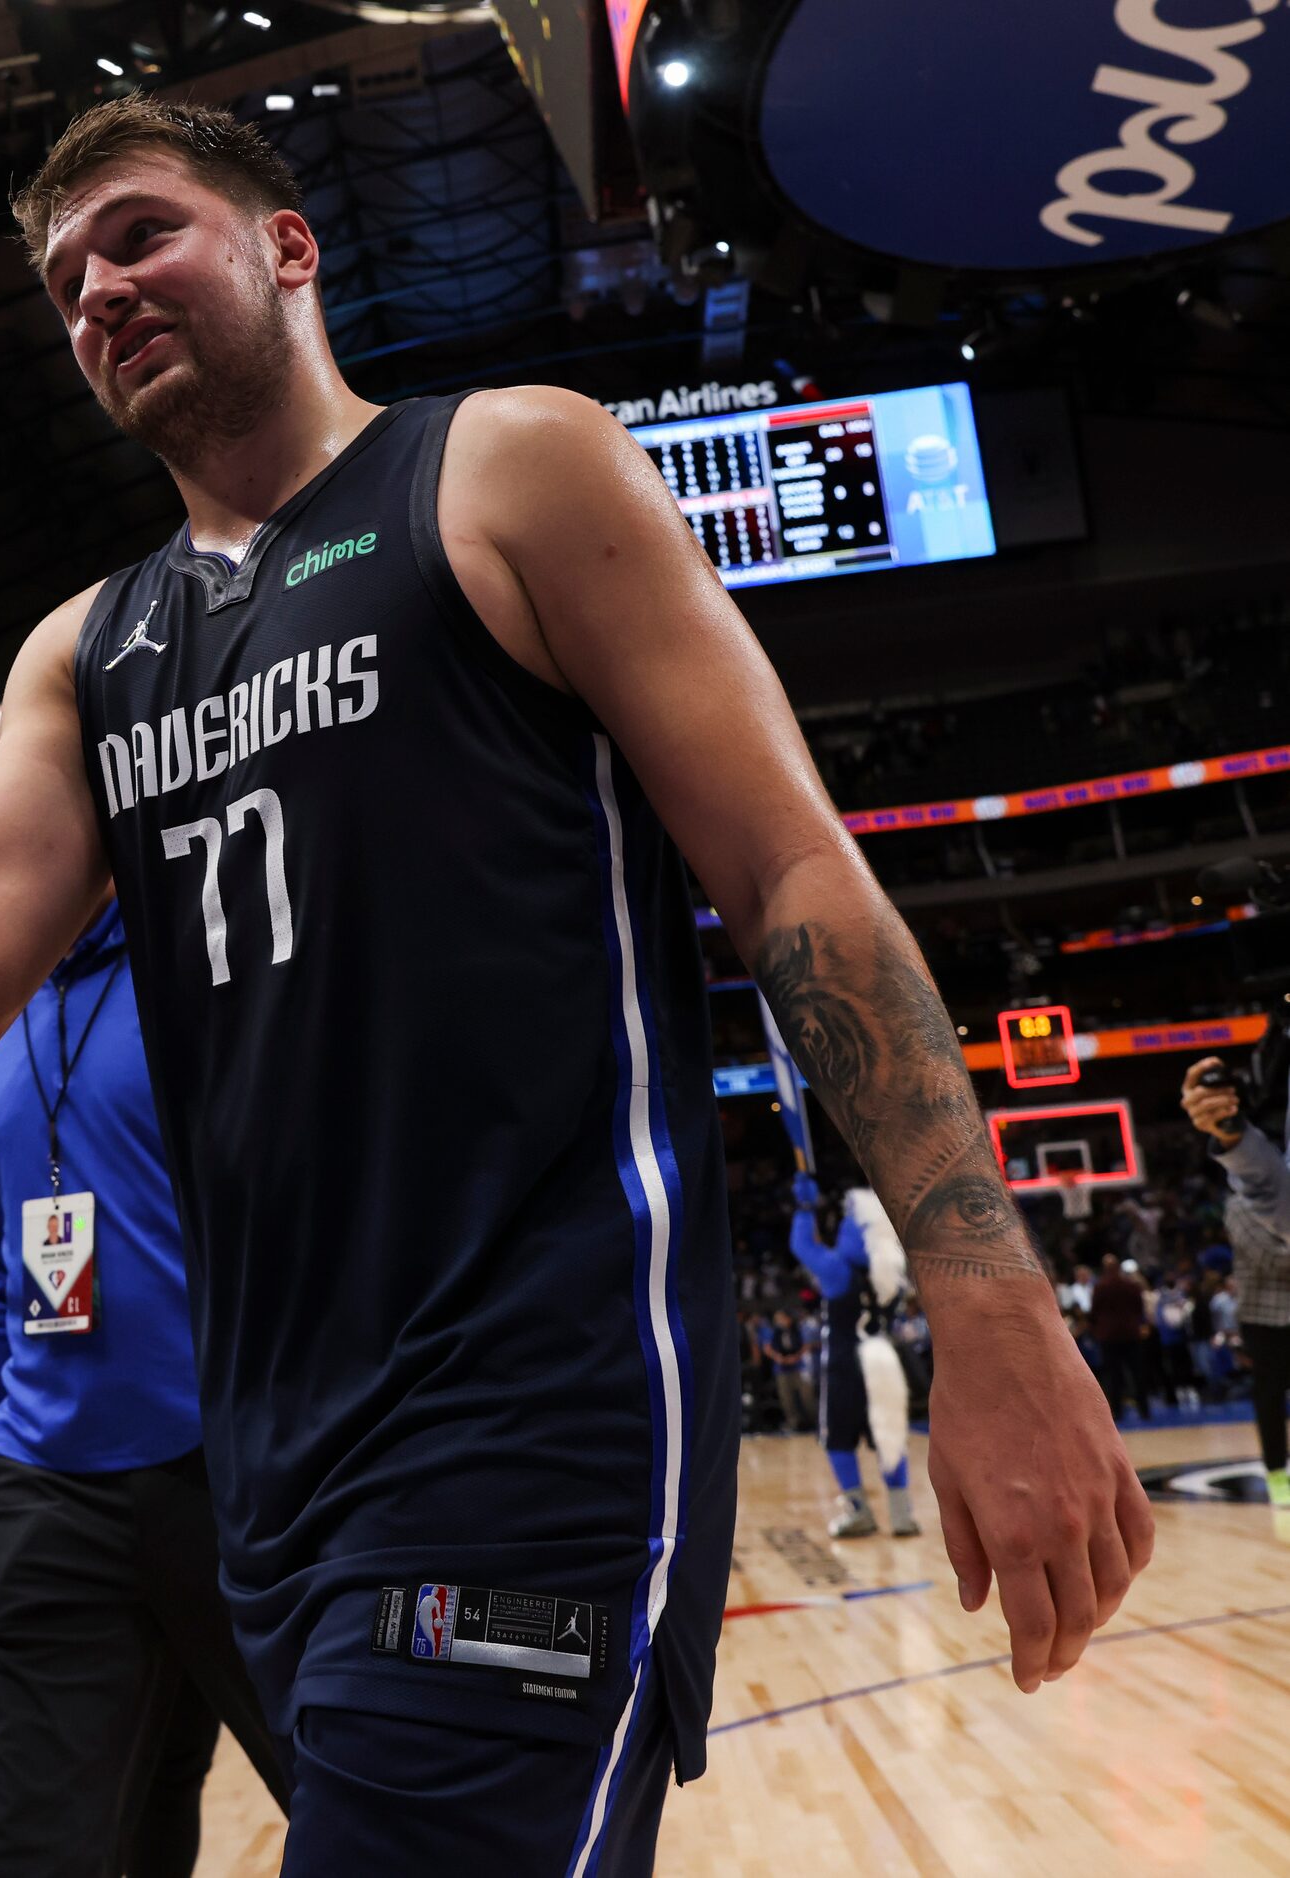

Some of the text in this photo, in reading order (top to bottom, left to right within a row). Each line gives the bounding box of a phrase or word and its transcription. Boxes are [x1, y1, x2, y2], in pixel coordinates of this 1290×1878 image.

[658, 380, 778, 419] Airlines
[285, 529, 378, 587] chime
[97, 634, 381, 820] MAVERICKS
[161, 787, 294, 988] 77
[464, 1607, 480, 1622] 54
[493, 1595, 553, 1610] ENGINEERED
[522, 1682, 577, 1700] STATEMENT EDITION
